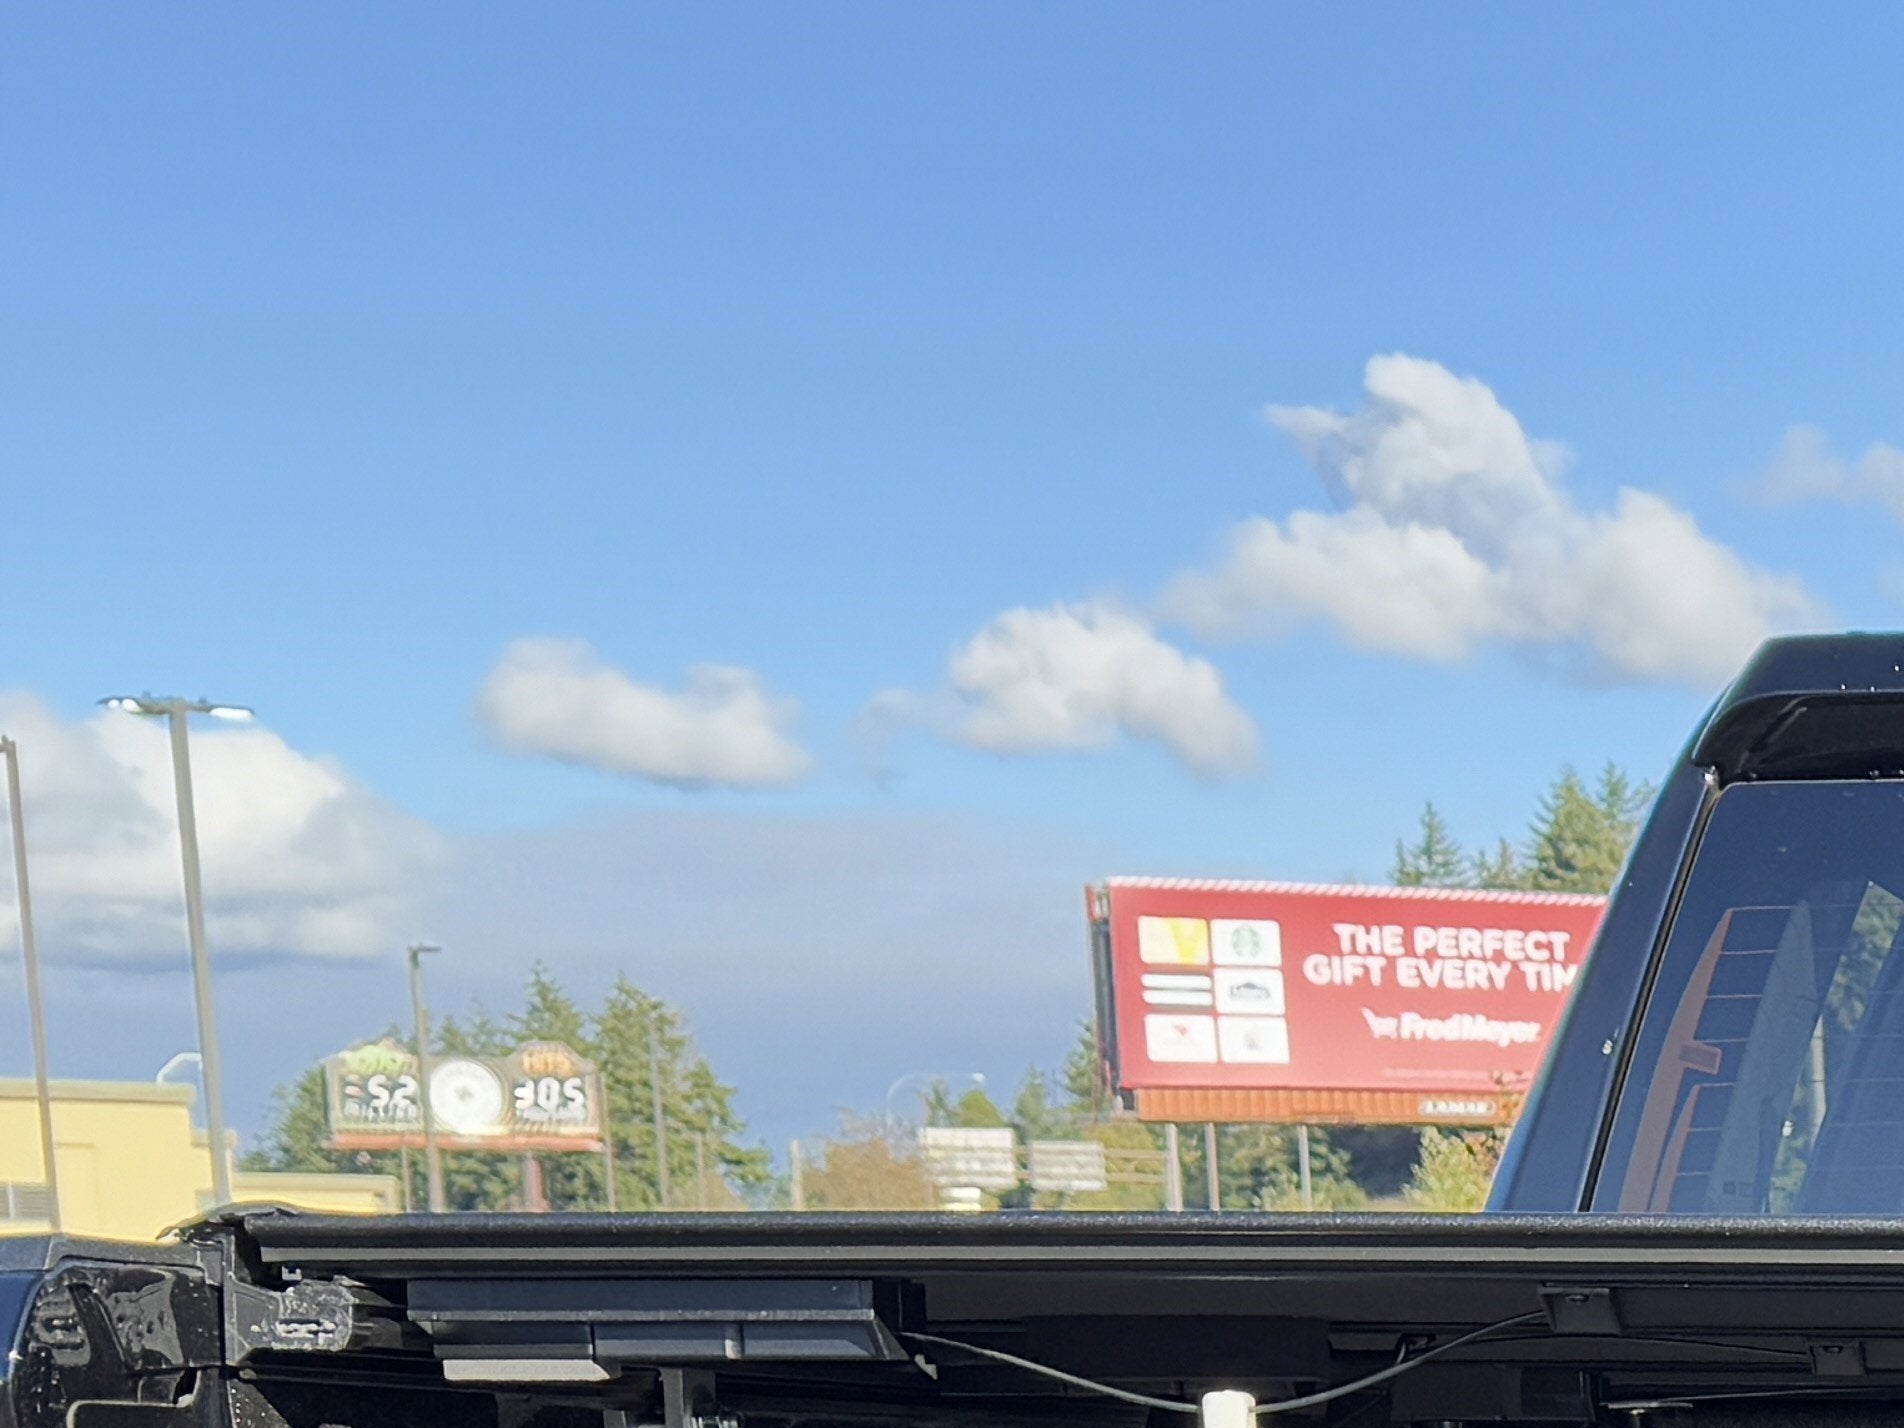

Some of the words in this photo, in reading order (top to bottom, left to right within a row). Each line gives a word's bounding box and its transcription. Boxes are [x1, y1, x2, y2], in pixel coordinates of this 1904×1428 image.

[1332, 923, 1405, 956] THE
[1413, 926, 1571, 962] PERFECT
[1302, 954, 1387, 986] GIFT
[1395, 957, 1512, 990] EVERY
[1518, 961, 1579, 992] TIM
